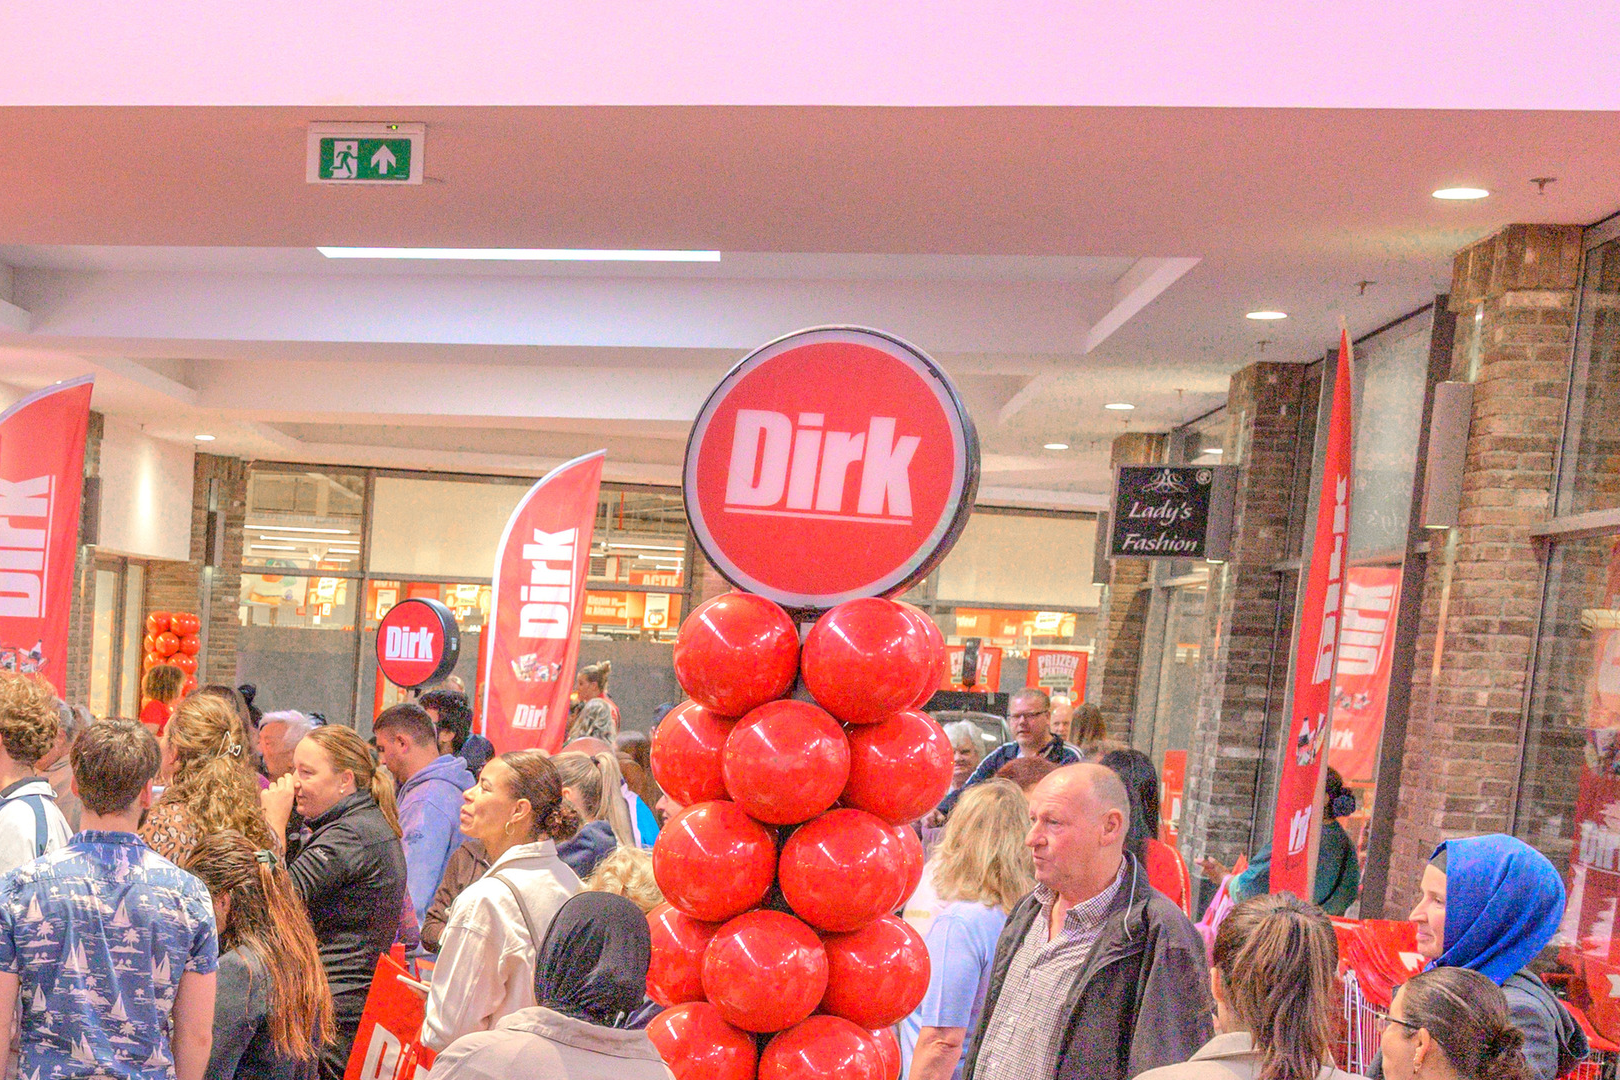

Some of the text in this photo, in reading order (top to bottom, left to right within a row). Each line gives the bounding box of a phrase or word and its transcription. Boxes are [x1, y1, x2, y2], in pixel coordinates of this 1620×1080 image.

[724, 409, 921, 518] Dirk
[1128, 499, 1192, 525] Lady's
[1121, 532, 1197, 553] Fashion
[519, 528, 577, 638] Dirk
[385, 626, 434, 660] Dirk
